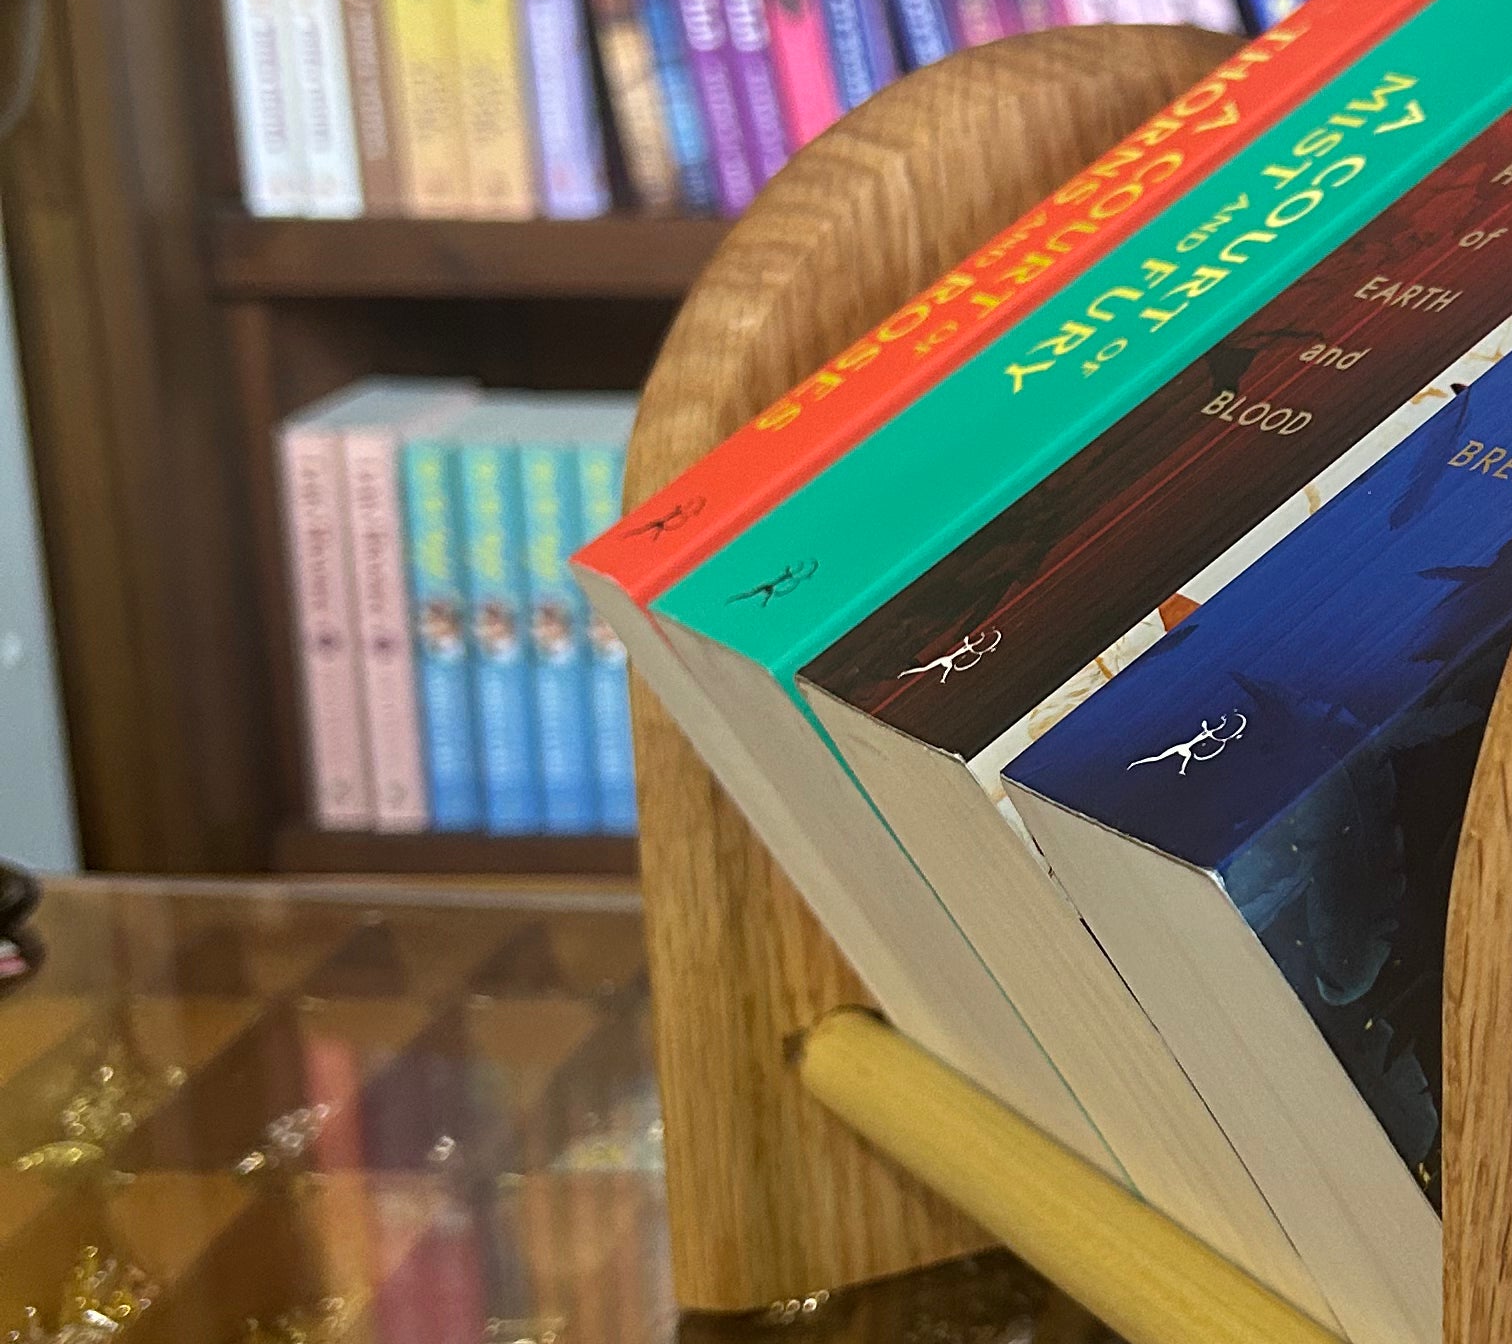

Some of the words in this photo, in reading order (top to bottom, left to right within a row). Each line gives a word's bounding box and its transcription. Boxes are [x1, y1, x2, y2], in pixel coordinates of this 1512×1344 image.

[1053, 18, 1312, 206] THORNS
[1193, 101, 1240, 134] A
[1260, 70, 1420, 190] MIST
[1373, 99, 1427, 135] A
[969, 152, 1185, 320] COURT
[1138, 155, 1367, 334] COURT
[1175, 191, 1251, 254] AND
[1458, 227, 1509, 253] of
[1353, 275, 1463, 314] EARTH
[755, 272, 977, 432] ROSES
[1003, 258, 1180, 395] FURY
[1298, 341, 1373, 372] and
[1200, 389, 1315, 437] BLOOD
